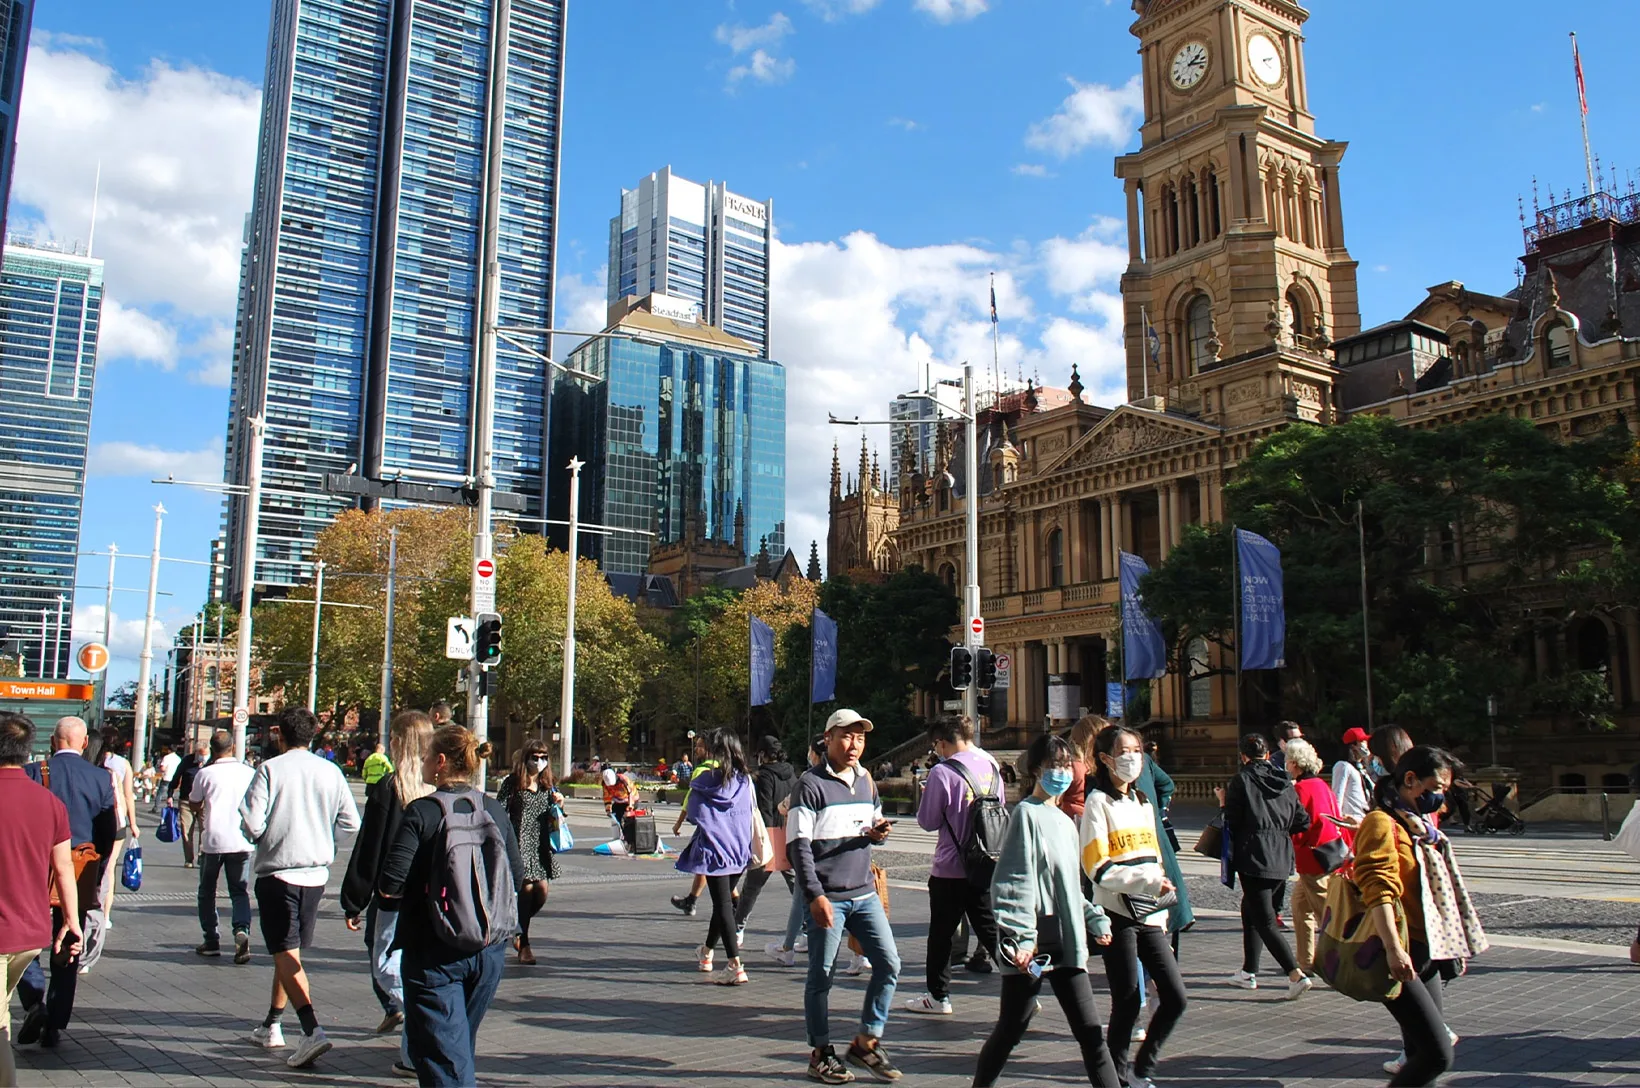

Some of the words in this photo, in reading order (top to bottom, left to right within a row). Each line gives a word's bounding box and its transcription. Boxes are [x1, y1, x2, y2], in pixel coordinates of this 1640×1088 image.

[725, 196, 767, 220] FRASER
[652, 305, 692, 320] Steadfast
[1243, 576, 1268, 584] NOW
[1244, 585, 1255, 593] AT
[1244, 595, 1282, 604] SYDNEY
[1245, 604, 1276, 613] TOWN
[1246, 614, 1270, 622] HALL
[88, 650, 101, 667] T
[10, 685, 35, 694] Town
[37, 687, 55, 695] Hall
